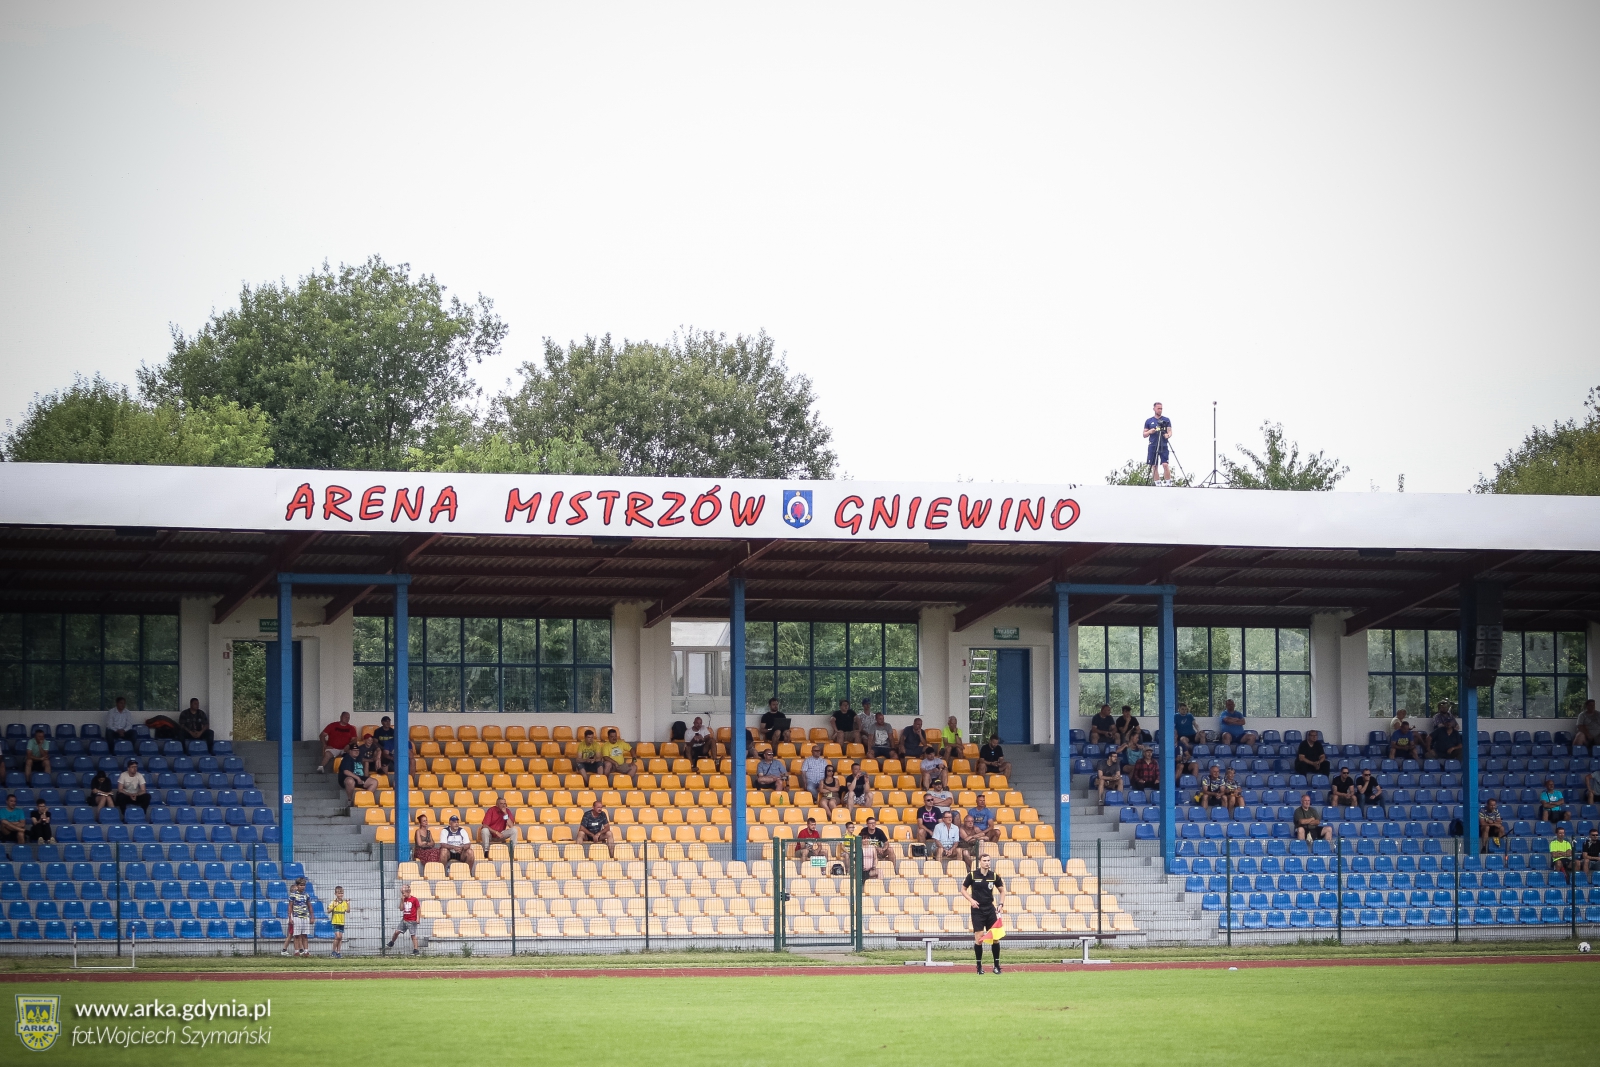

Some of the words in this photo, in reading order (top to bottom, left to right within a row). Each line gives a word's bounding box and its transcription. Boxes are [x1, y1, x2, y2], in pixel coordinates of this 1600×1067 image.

[285, 483, 458, 523] ARENA
[504, 485, 765, 528] MISTRZÓW
[834, 494, 1081, 535] GNIEWINO
